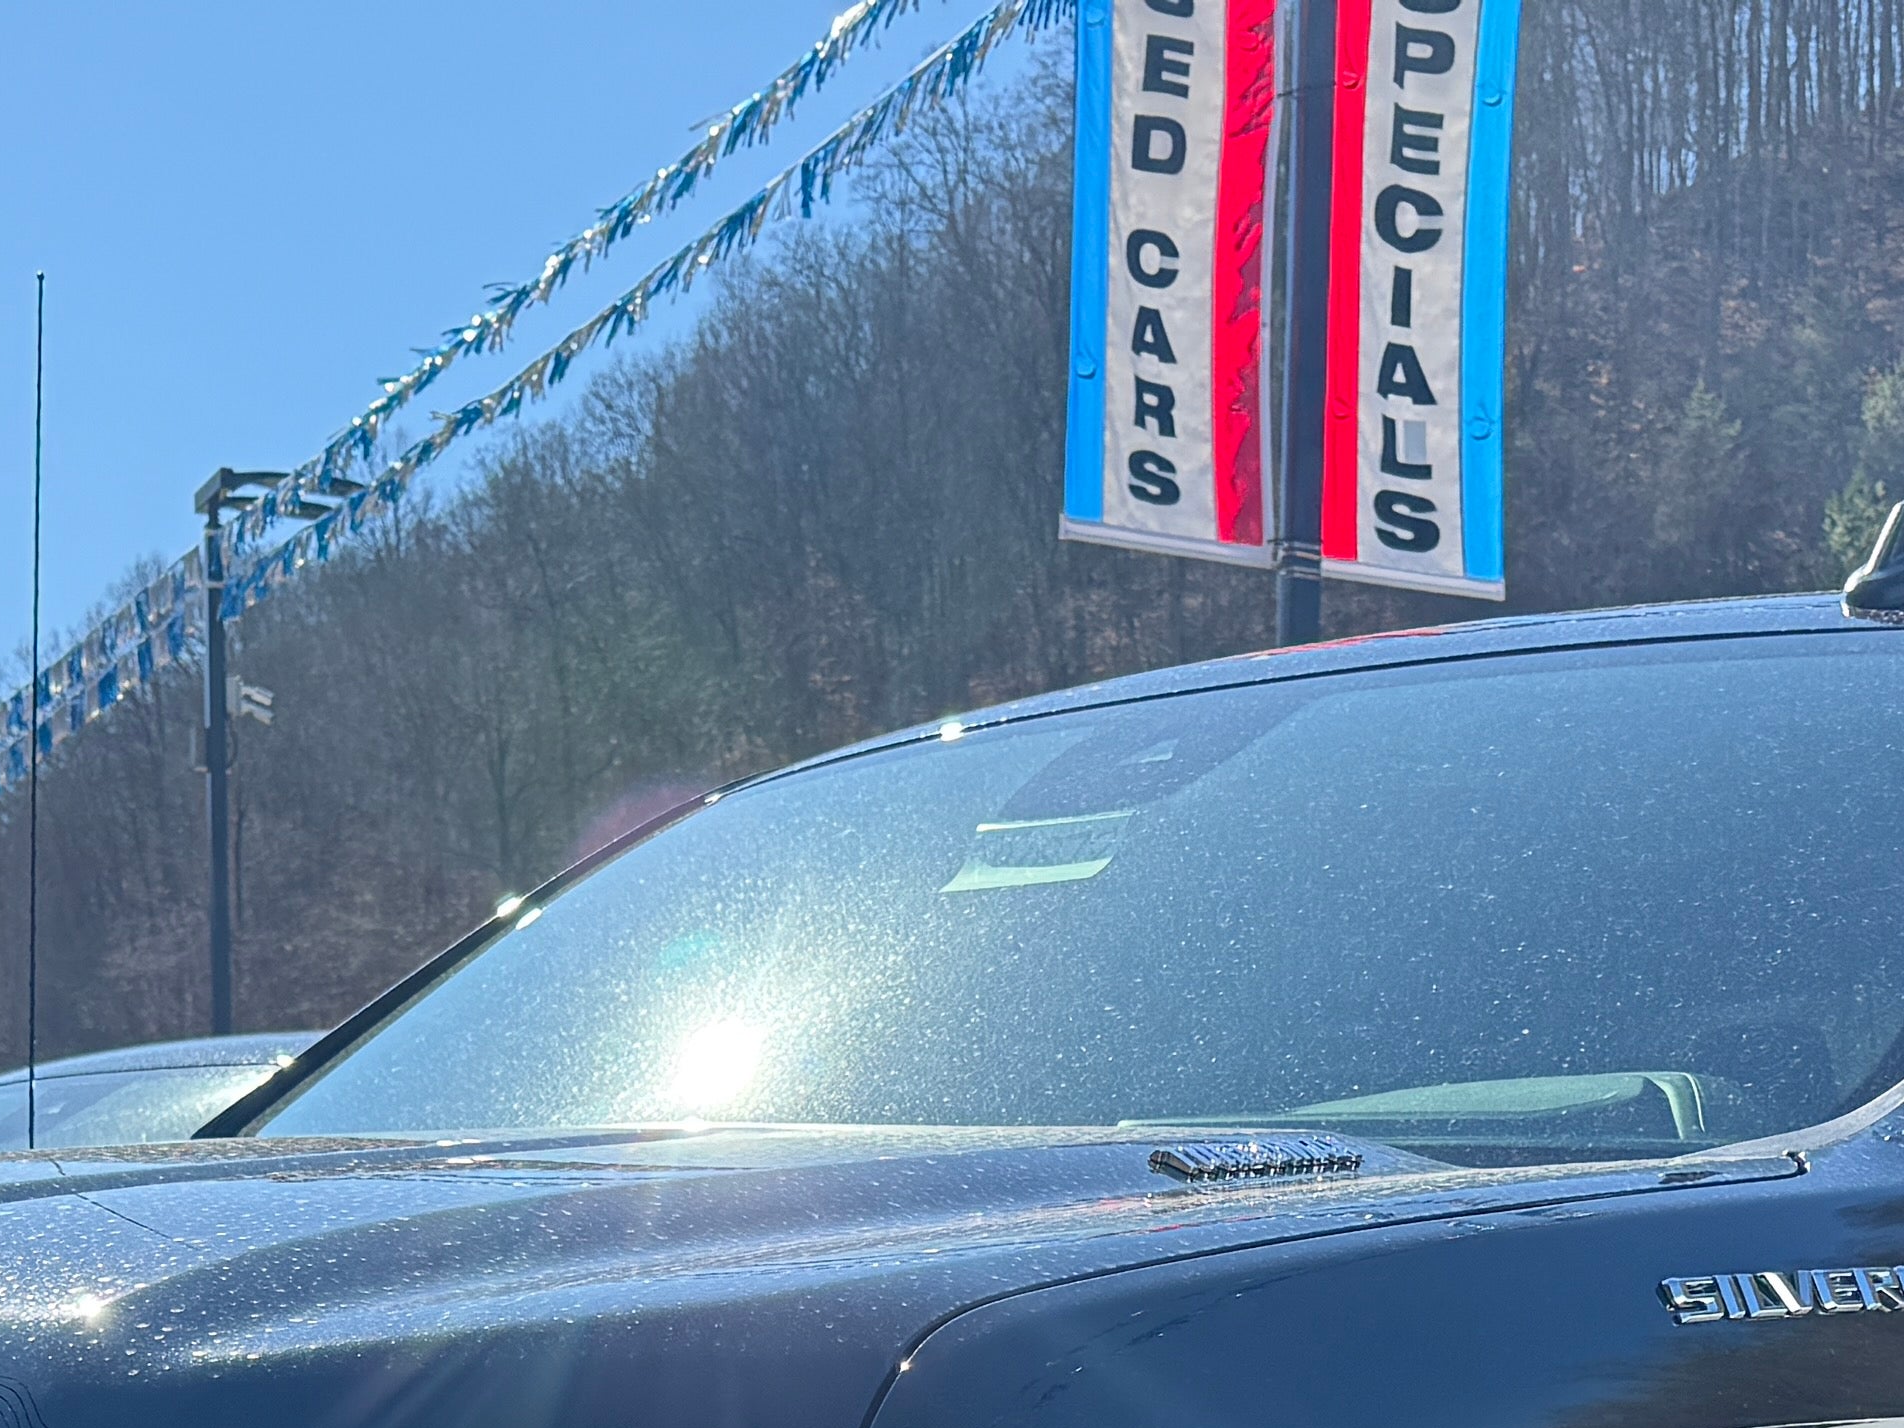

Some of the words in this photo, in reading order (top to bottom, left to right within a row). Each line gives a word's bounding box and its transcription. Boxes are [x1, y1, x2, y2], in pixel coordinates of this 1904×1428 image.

[1131, 0, 1194, 174] ED
[1126, 228, 1181, 506] CARS
[1374, 0, 1461, 553] PECIALS
